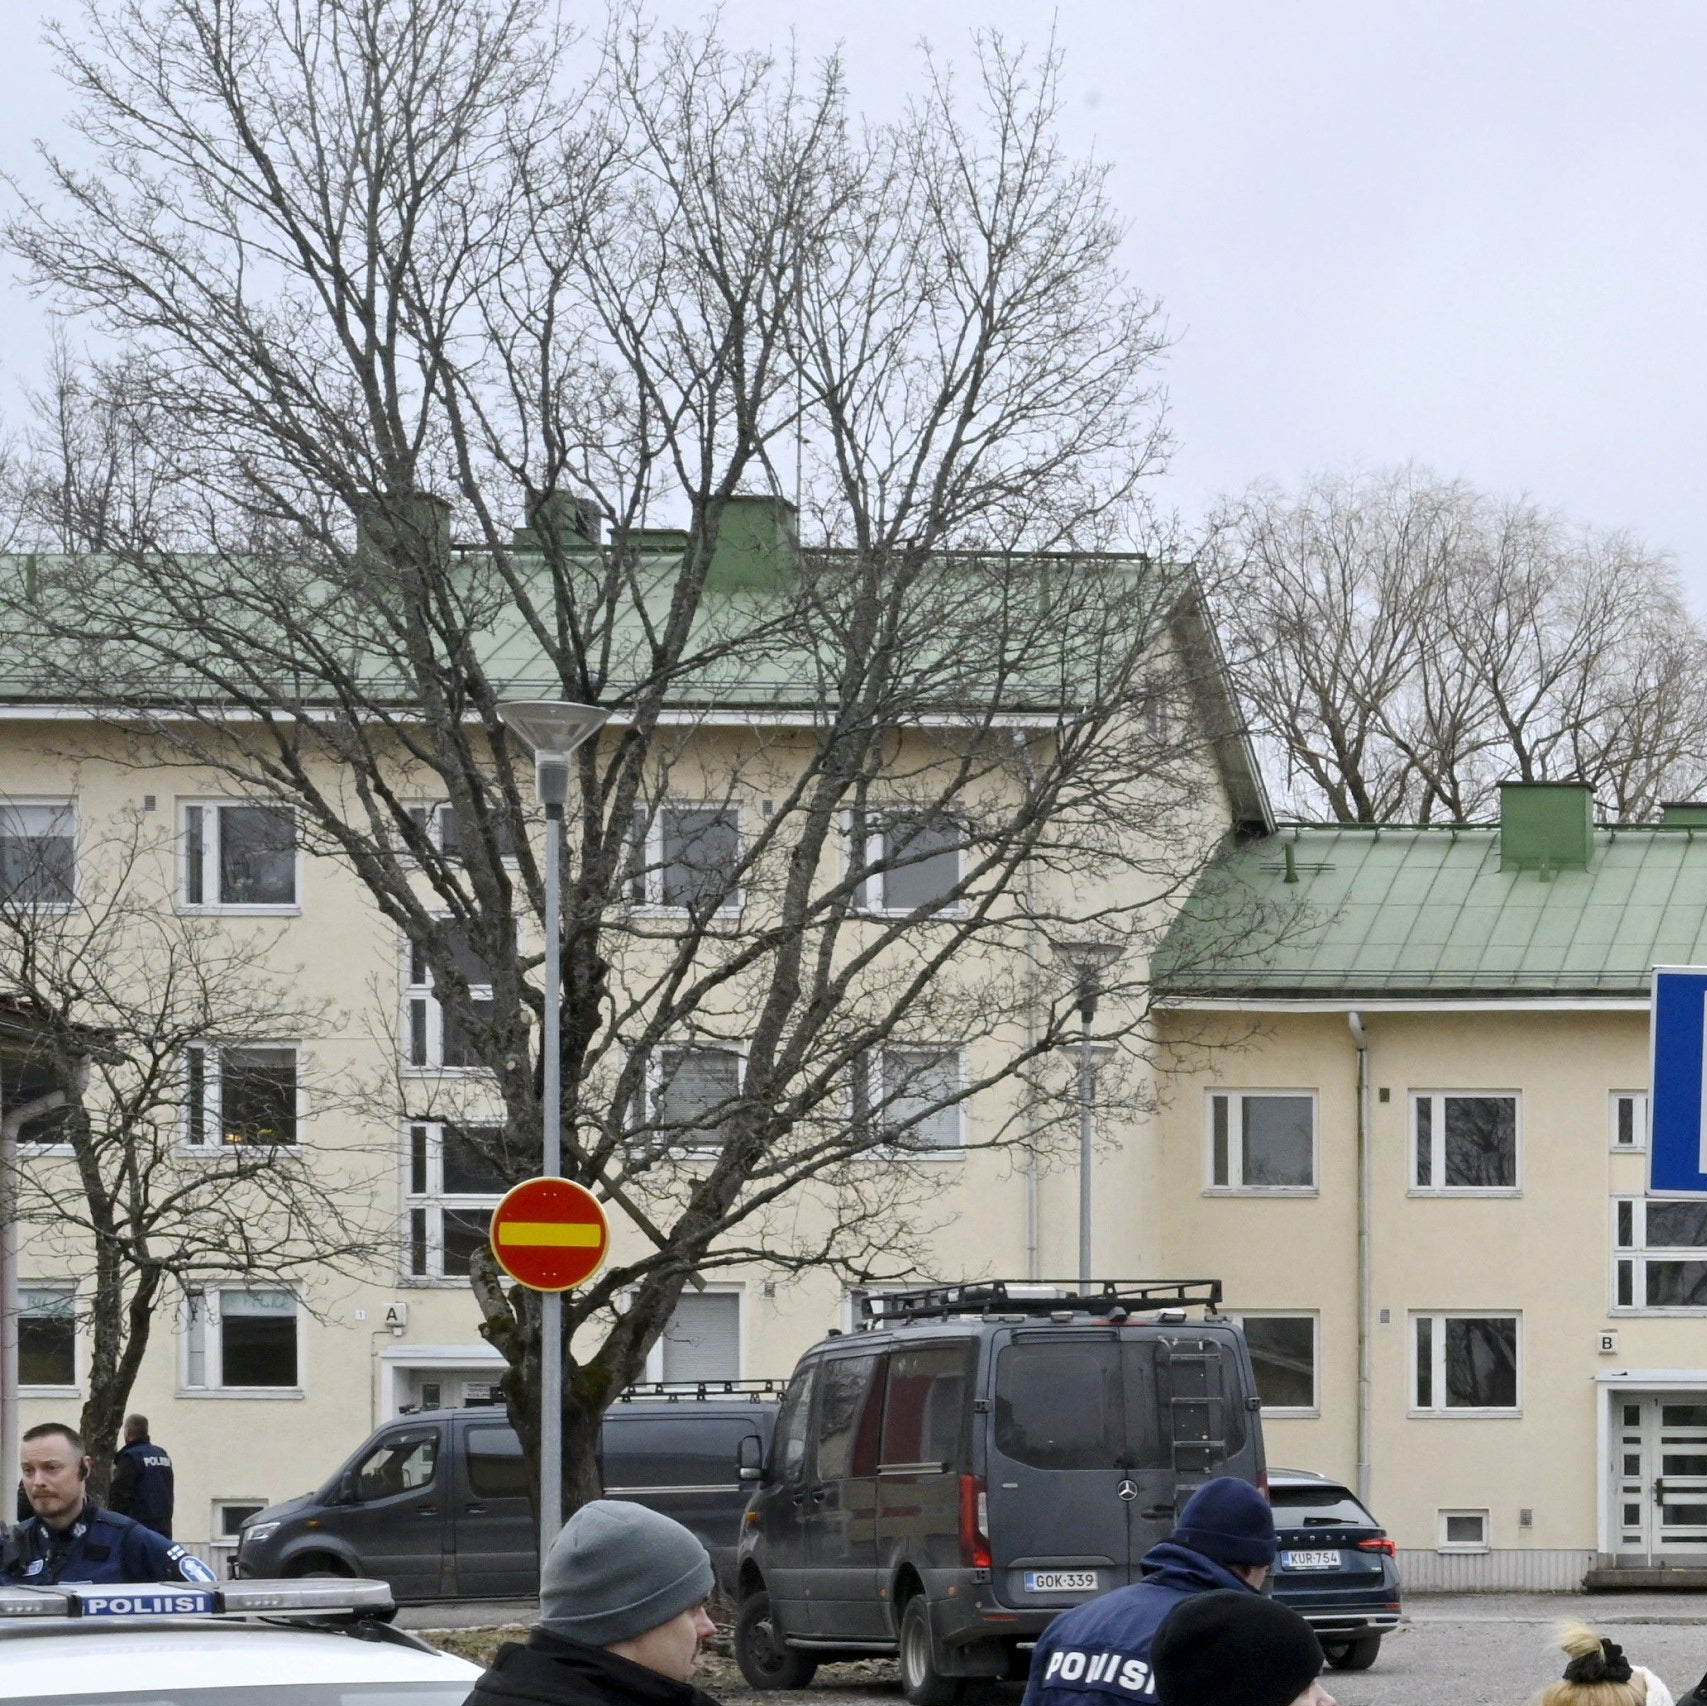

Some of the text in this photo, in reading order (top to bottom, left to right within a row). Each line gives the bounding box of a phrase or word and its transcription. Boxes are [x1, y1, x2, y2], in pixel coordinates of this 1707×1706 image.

[386, 1307, 398, 1321] A
[1602, 1336, 1612, 1350] B
[1291, 1552, 1338, 1565] KUR-754
[1036, 1574, 1094, 1588] GOK-339
[89, 1597, 205, 1614] POLIISI
